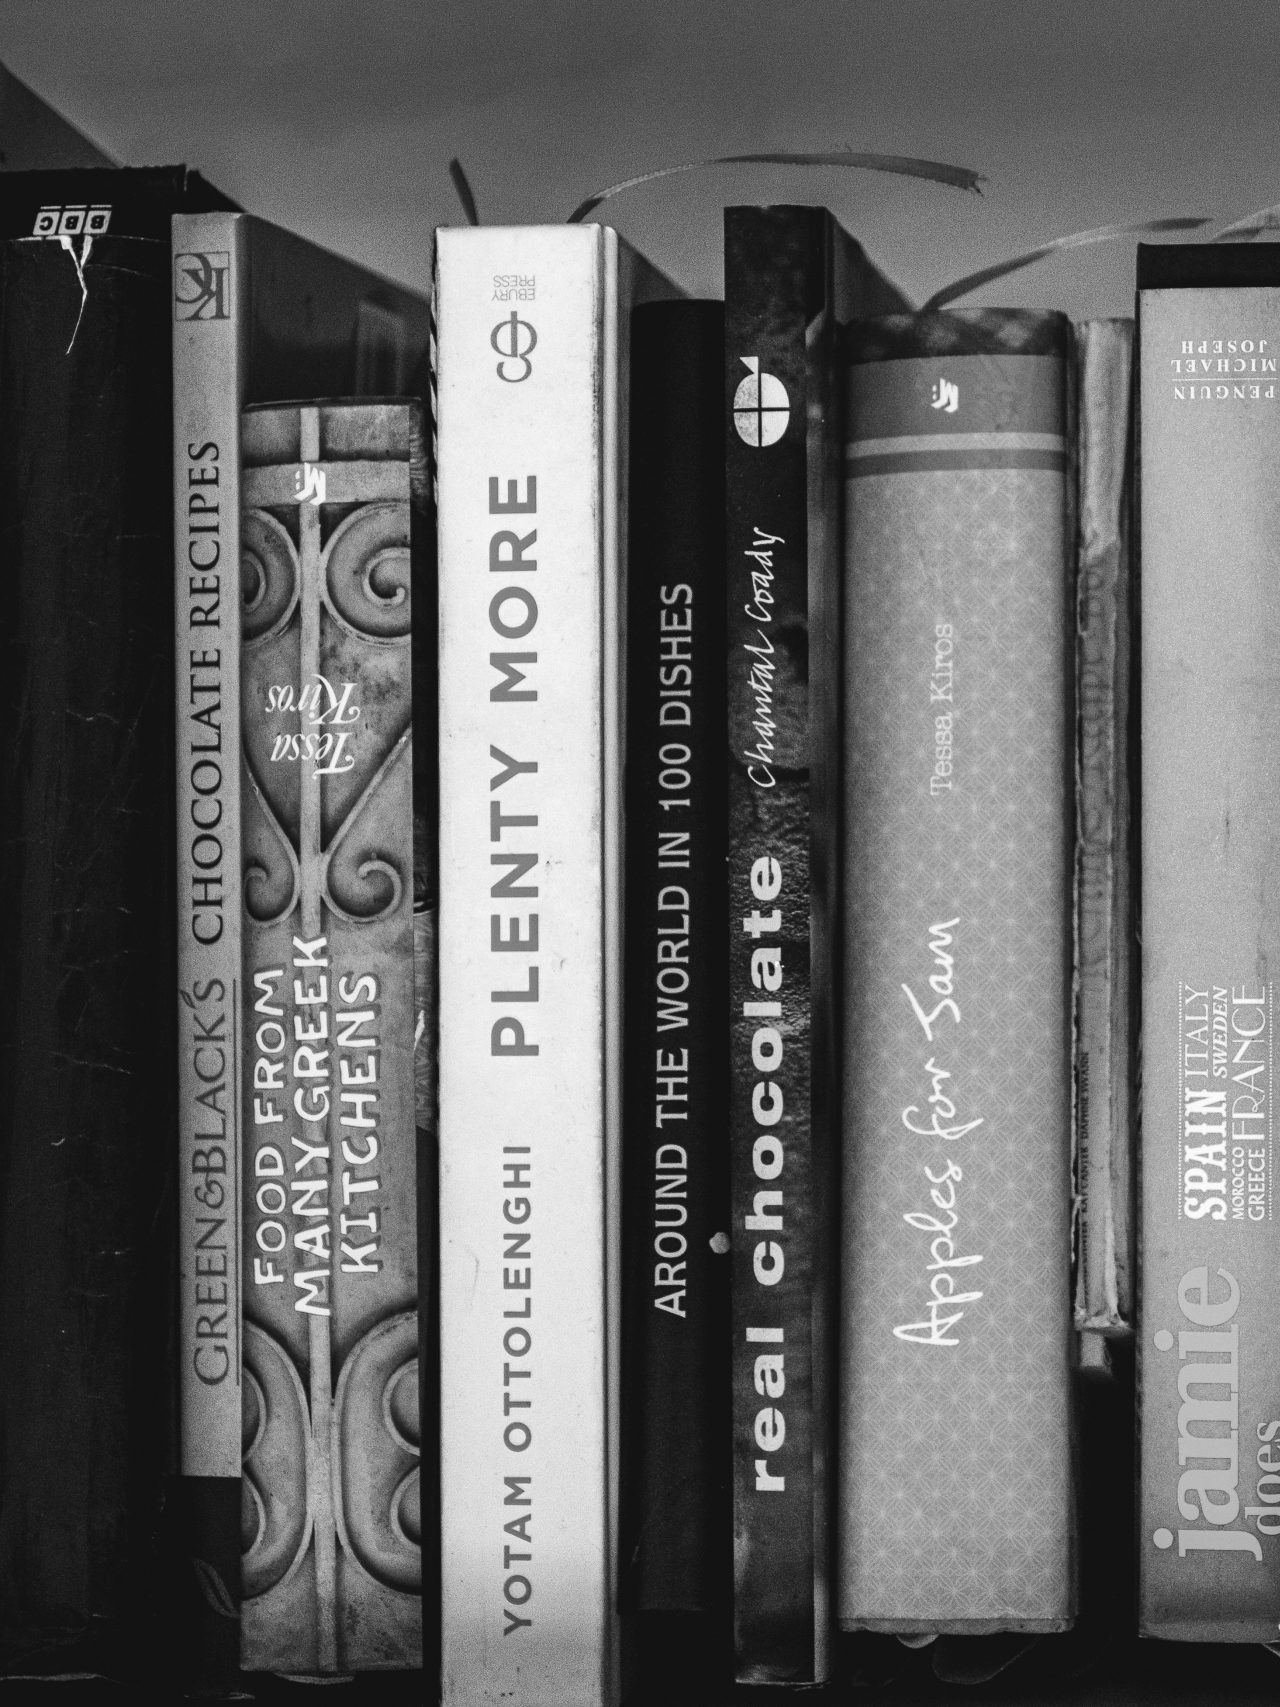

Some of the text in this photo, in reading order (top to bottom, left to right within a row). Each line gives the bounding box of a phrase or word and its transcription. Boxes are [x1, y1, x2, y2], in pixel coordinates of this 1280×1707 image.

[33, 211, 113, 236] BBC
[491, 288, 537, 302] EBURY
[492, 275, 537, 288] PRESS
[1170, 358, 1277, 373] MICHAEL
[1173, 385, 1276, 400] PENGUIN
[1180, 340, 1268, 354] JOSEPH
[188, 442, 220, 627] RECIPES
[265, 673, 361, 724] Kiros
[271, 731, 353, 779] Tessa
[489, 475, 539, 1056] PLENTY MORE
[744, 527, 784, 787] Chantal Coady
[930, 618, 953, 795] Tessa Kiros
[190, 650, 223, 945] CHOCOLATE
[655, 584, 692, 1317] AROUND THE WORLD IN 100 DISHES
[1213, 986, 1227, 1078] SWEDEN
[255, 970, 286, 1284] FOOD FROM
[291, 937, 330, 1316] MANY GREEK
[338, 972, 383, 1273] KITCHENS
[743, 857, 785, 1491] real chocolate
[893, 918, 983, 1346] Apples for Jam
[1184, 985, 1227, 1220] SPAIN ITALY
[1232, 986, 1264, 1219] MOROCCO FRANCE
[1248, 1149, 1265, 1221] GREECE
[503, 1147, 533, 1636] YOTAM OTTOLENGHI
[1153, 1266, 1264, 1562] jamie
